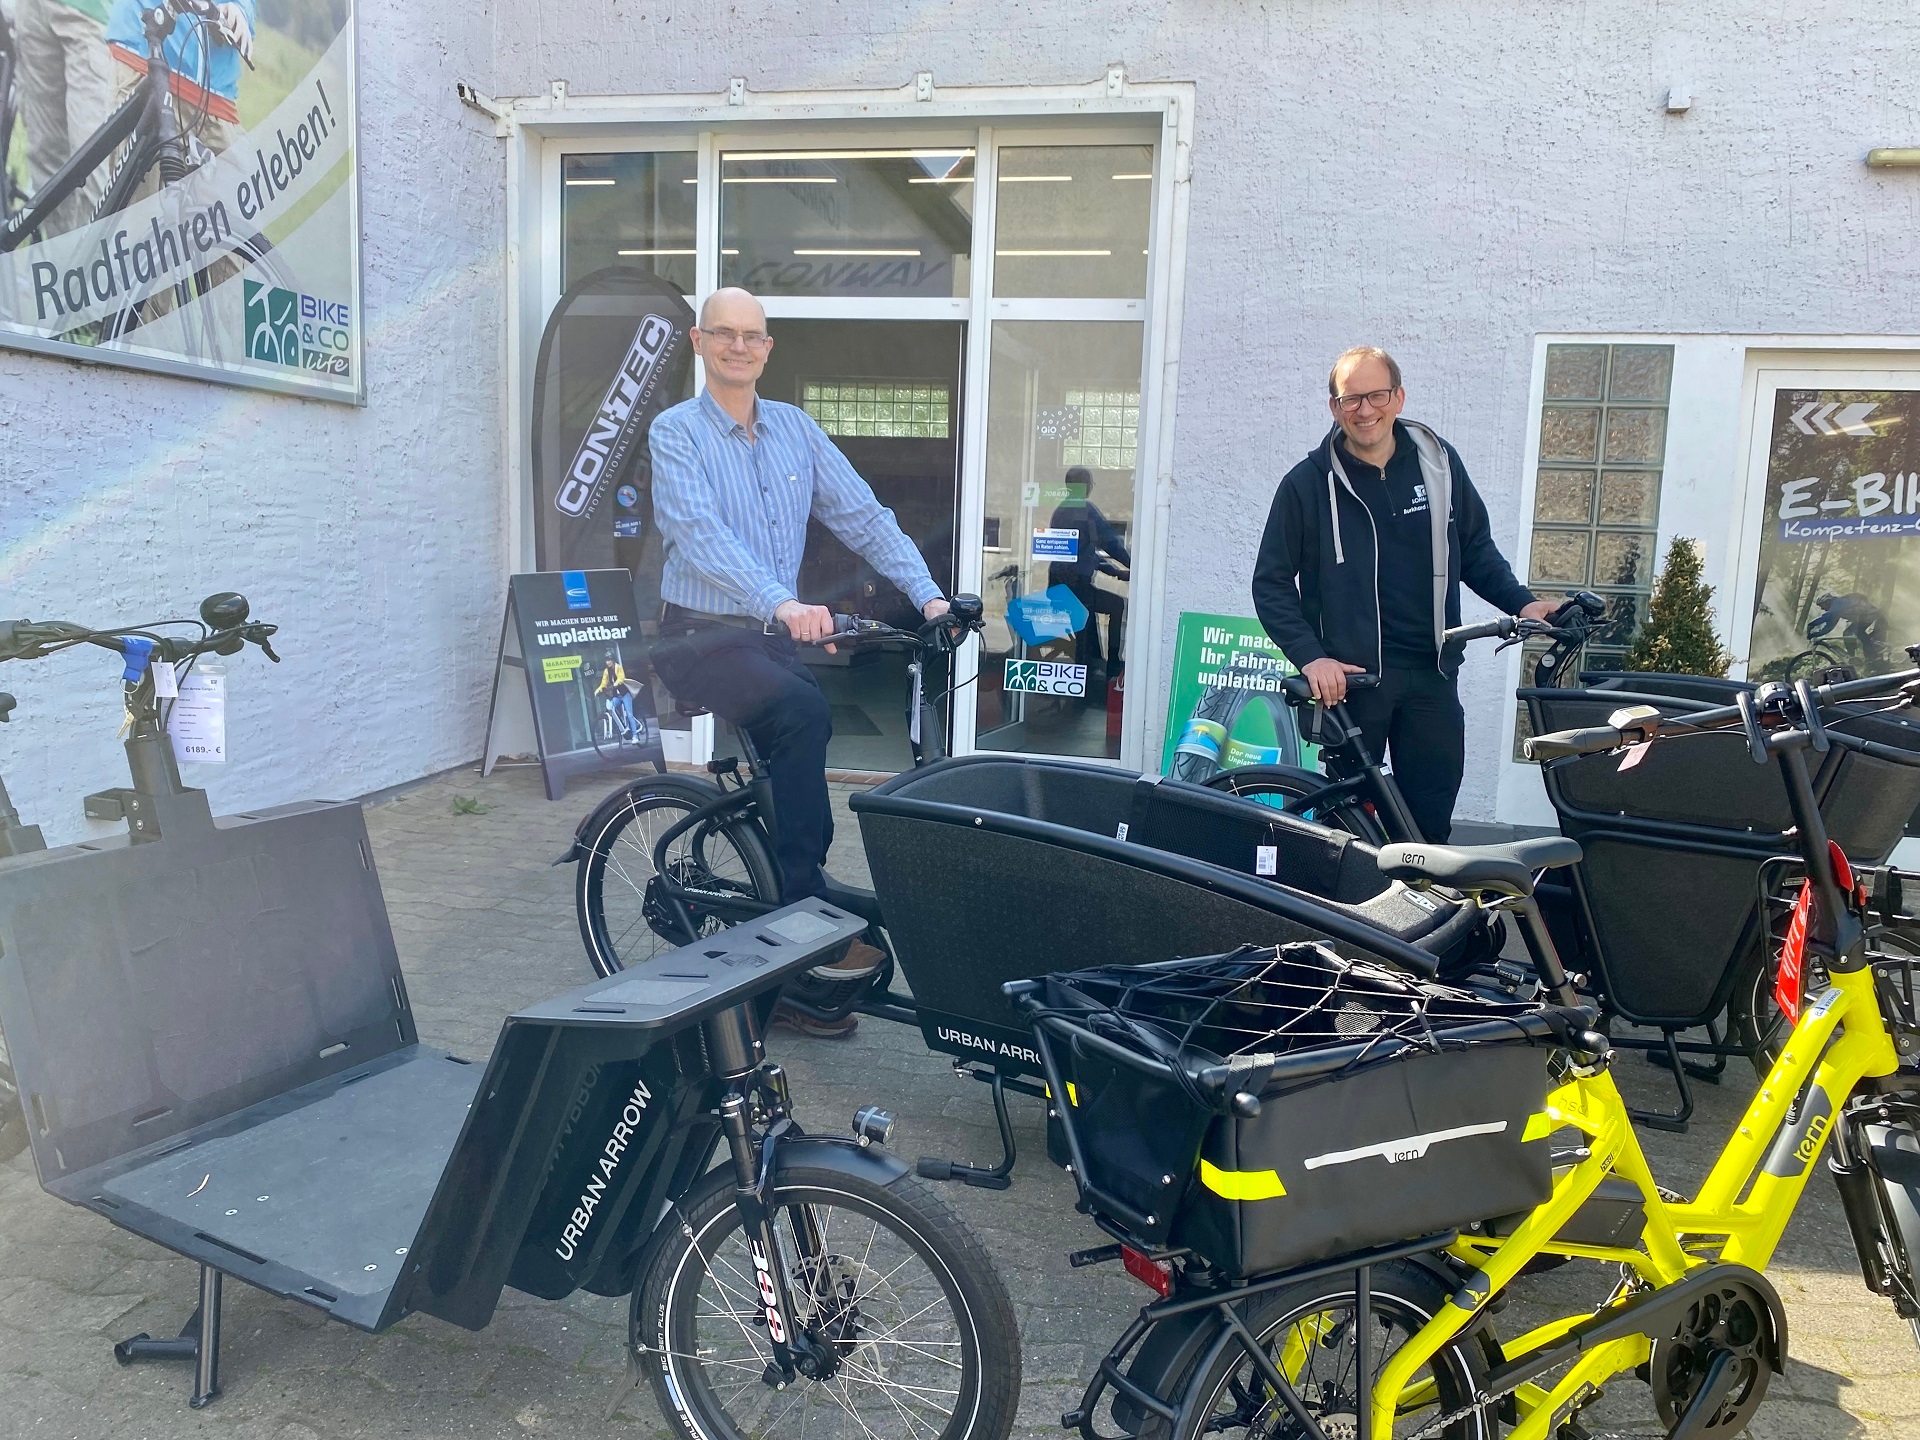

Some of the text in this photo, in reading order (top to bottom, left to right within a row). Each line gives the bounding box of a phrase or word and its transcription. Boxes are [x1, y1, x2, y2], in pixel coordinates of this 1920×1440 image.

[31, 199, 232, 320] Radfahren
[237, 79, 337, 220] erleben!
[742, 261, 947, 288] CONWAY
[301, 294, 349, 327] BIKE
[302, 322, 349, 352] & CO
[584, 439, 631, 520] PROFESSIONAL
[627, 409, 643, 435] BIKE
[640, 329, 683, 406] COMPONENTS
[1784, 518, 1920, 543] Kompetenz-
[550, 617, 579, 626] MACHEN
[580, 616, 596, 624] DEIN
[597, 615, 619, 623] E-BIKE
[1203, 626, 1234, 645] Wir
[545, 658, 580, 668] MARATHON
[1200, 647, 1226, 665] Ihr
[548, 672, 570, 680] E-PLUS
[1038, 663, 1086, 679] BIKE
[1038, 680, 1084, 695] & CO
[185, 746, 222, 754] 6189,- €
[1230, 748, 1262, 760] Der neue
[1402, 852, 1425, 866] tern
[937, 1026, 996, 1053] URBAN
[1793, 1115, 1829, 1163] tern
[1394, 1149, 1419, 1163] tern
[555, 1173, 607, 1261] URBAN
[598, 1079, 652, 1180] ARROW
[680, 1413, 702, 1440] ALBE
